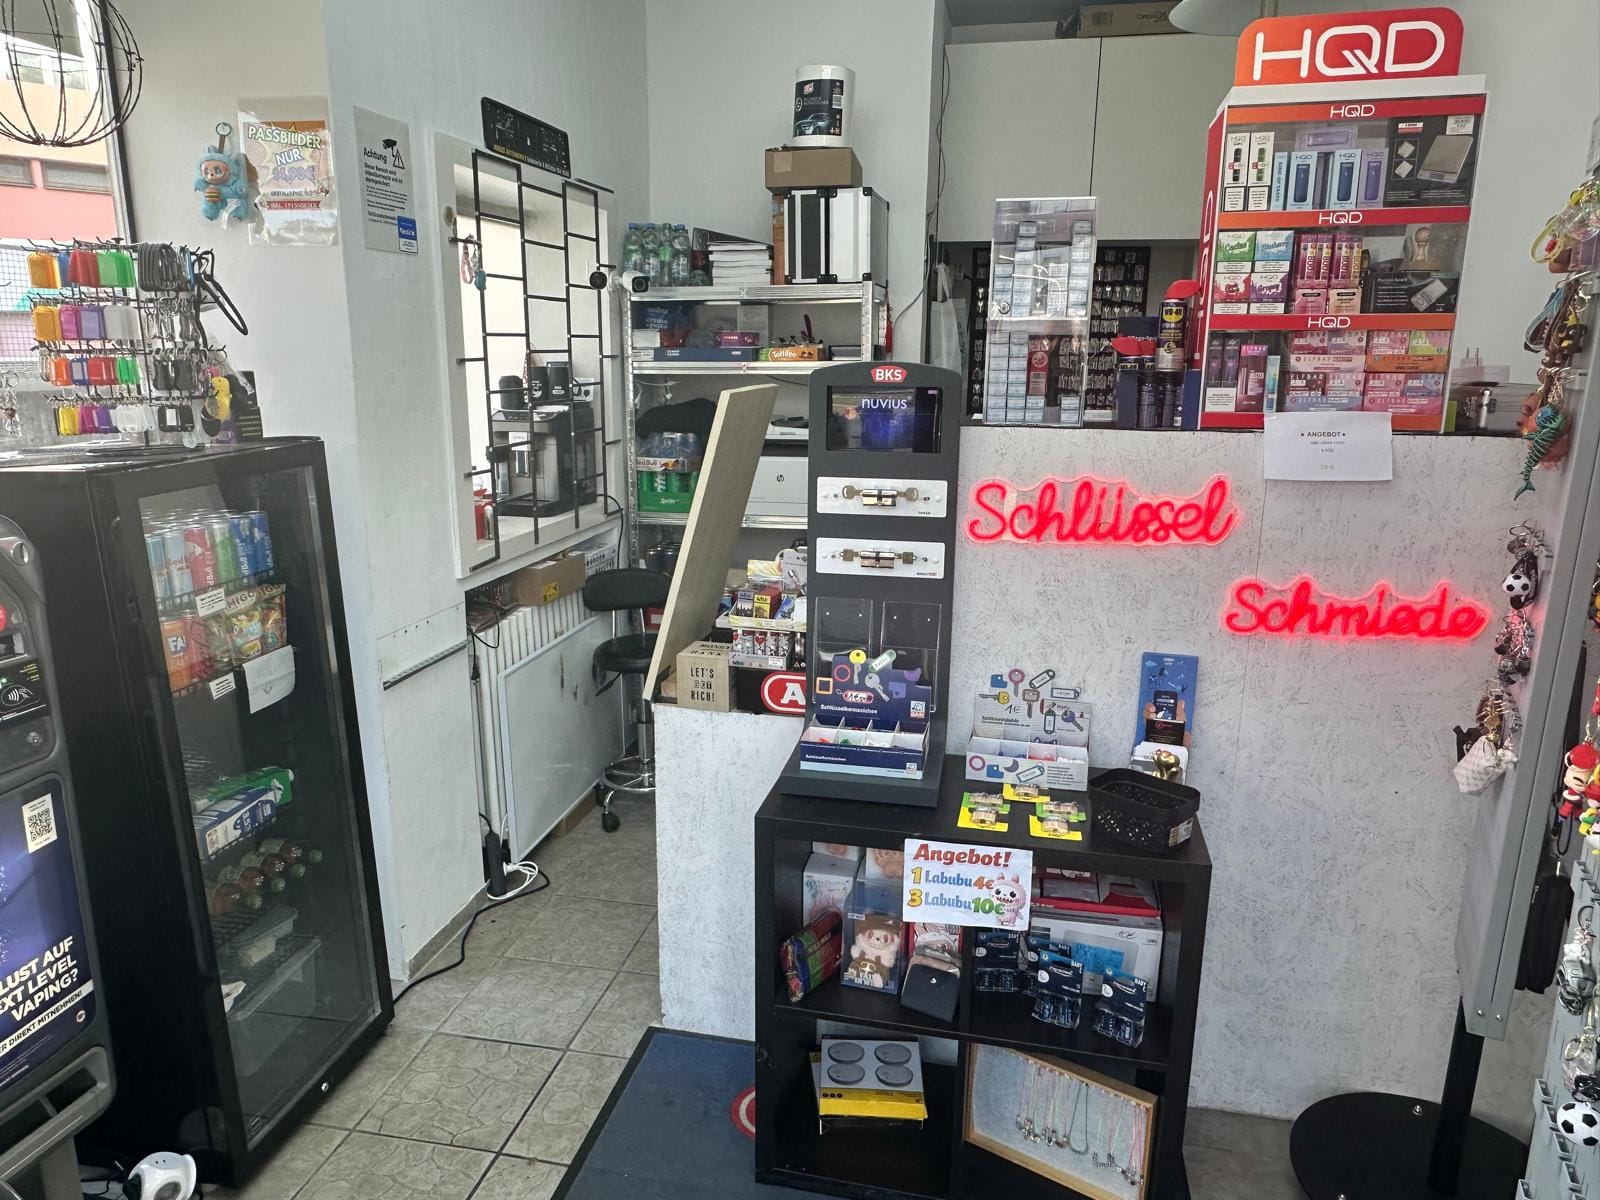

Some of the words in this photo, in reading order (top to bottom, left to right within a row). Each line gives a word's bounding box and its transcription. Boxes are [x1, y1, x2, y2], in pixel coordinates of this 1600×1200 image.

[1252, 20, 1446, 81] HQD
[1329, 104, 1376, 119] HQD
[247, 125, 321, 149] PASSBILDER
[275, 147, 302, 167] NUR
[363, 147, 387, 165] Achtung
[1318, 211, 1363, 225] HQD
[1307, 315, 1351, 329] HQD
[875, 368, 902, 382] BKS
[861, 396, 908, 409] nuvius
[967, 475, 1238, 545] Schlüssel
[1223, 575, 1490, 640] Schmiede
[690, 666, 715, 679] LET'S
[690, 691, 716, 702] RICH!
[913, 843, 1012, 868] Angebot!
[910, 867, 923, 884] 1
[924, 870, 973, 888] Labubu
[973, 875, 994, 890] 4€
[907, 888, 923, 907] 3
[924, 891, 973, 910] Labubu
[972, 897, 1006, 915] 10€
[43, 935, 73, 968] AUF
[27, 954, 77, 995] LEVEL
[11, 967, 79, 1022] VAPING?
[9, 1023, 37, 1047] DIREKT
[38, 990, 82, 1026] MITNEHMEN!
